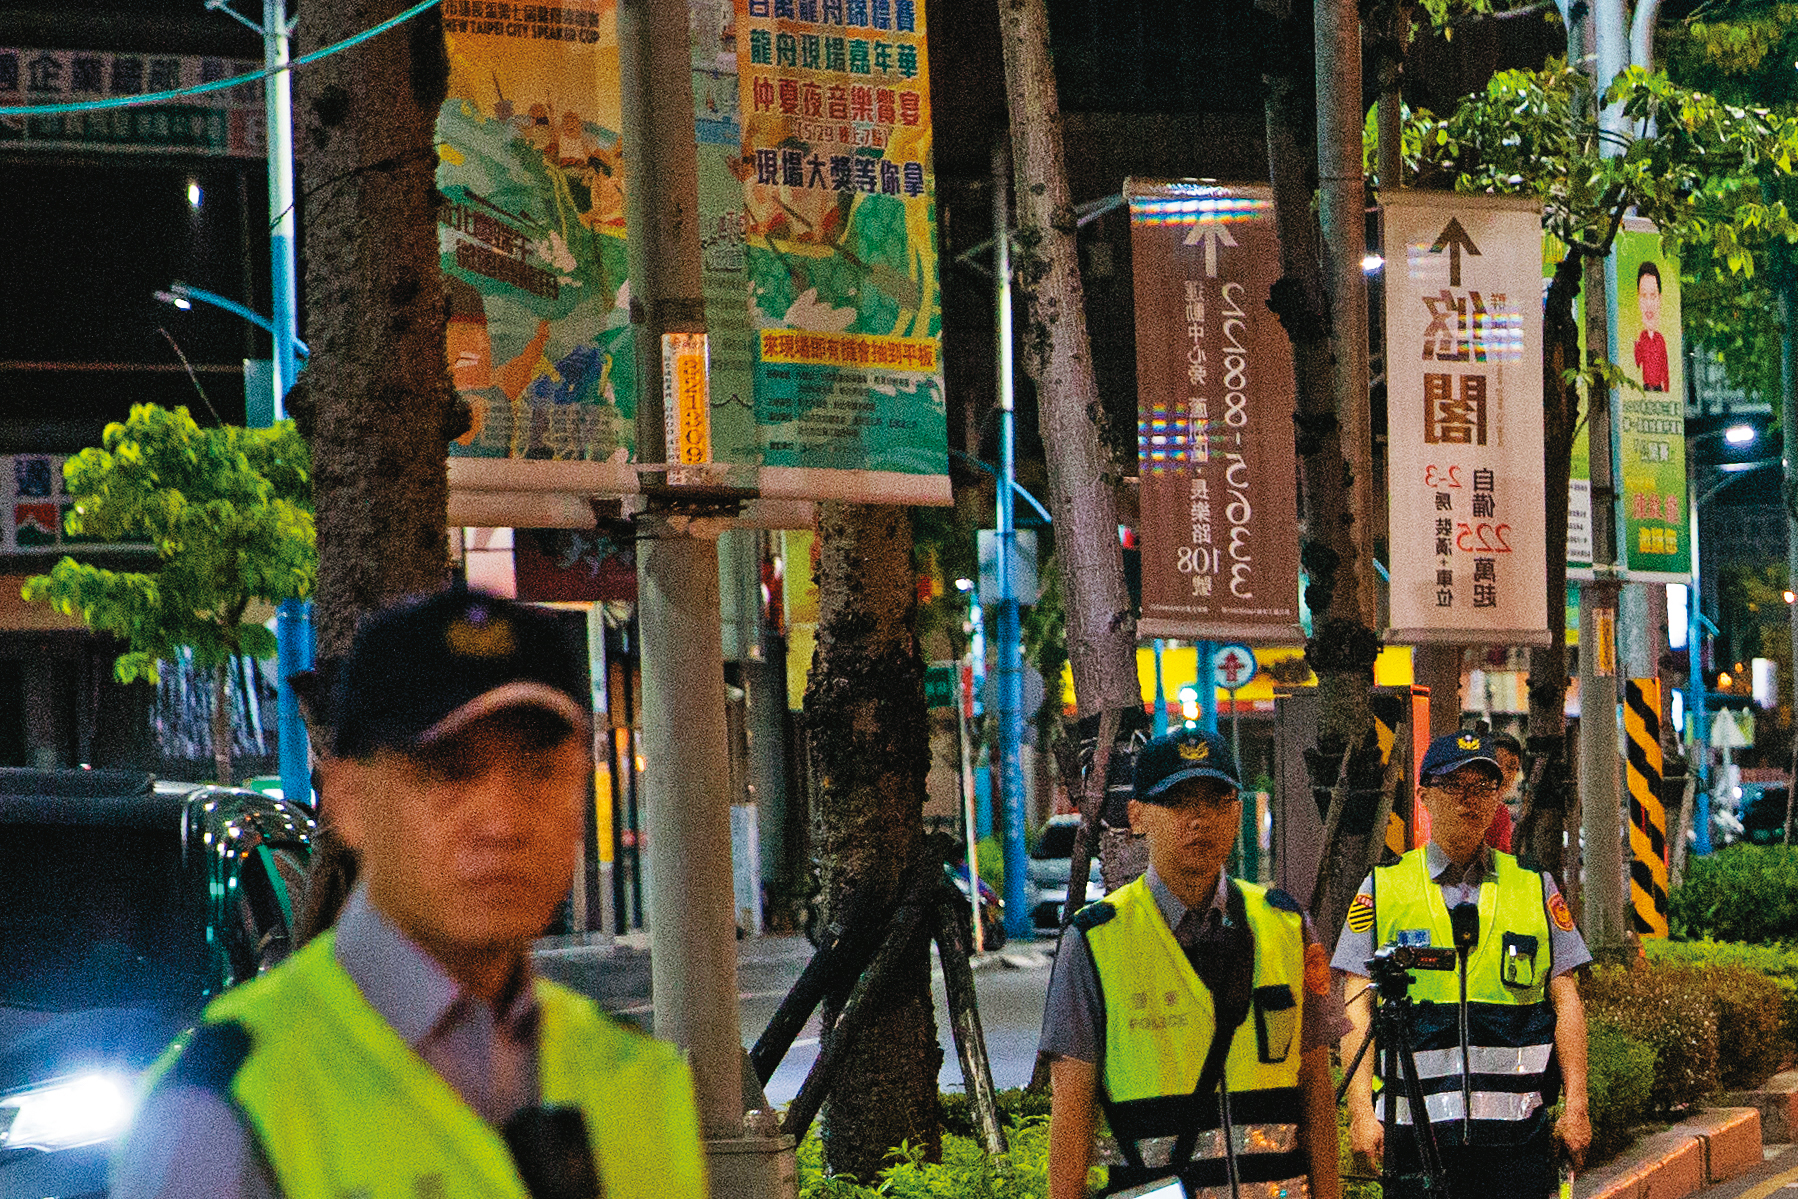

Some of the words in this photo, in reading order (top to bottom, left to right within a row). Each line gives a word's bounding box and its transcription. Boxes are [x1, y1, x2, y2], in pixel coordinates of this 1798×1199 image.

[750, 28, 918, 79] 龍舟現場嘉年華
[752, 75, 921, 126] 仲夏夜音樂饗宴
[756, 148, 926, 198] 現場大獎等你拿
